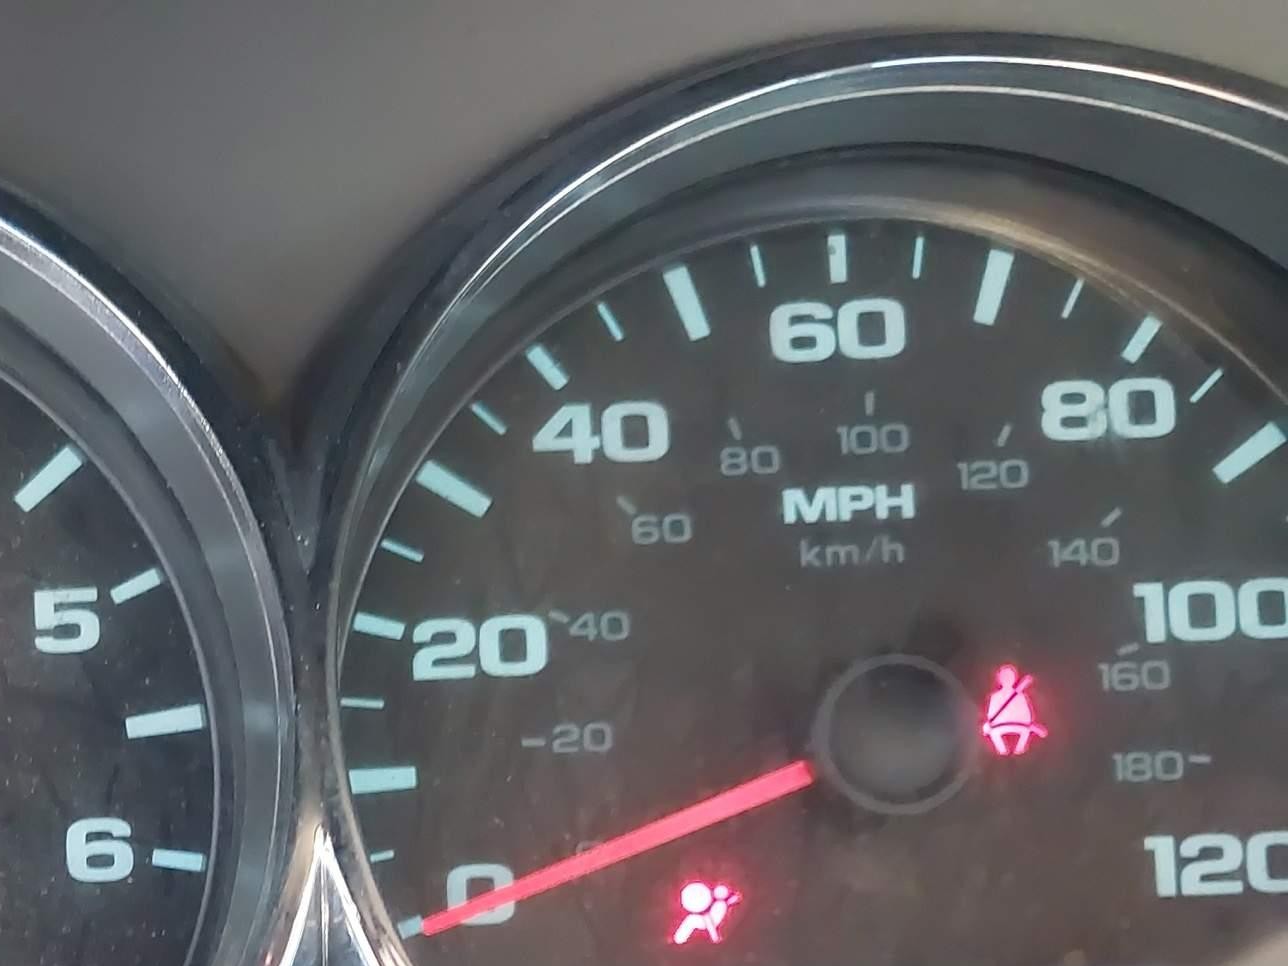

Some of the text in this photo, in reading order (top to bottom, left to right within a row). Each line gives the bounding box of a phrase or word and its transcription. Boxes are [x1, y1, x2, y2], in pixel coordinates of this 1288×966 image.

[769, 298, 906, 363] 60
[1041, 377, 1177, 441] 80
[532, 401, 670, 464] 40
[836, 424, 910, 455] 100
[720, 446, 781, 476] 80
[956, 459, 1029, 490] 120
[781, 483, 916, 525] MPH
[631, 514, 693, 544] 60
[799, 535, 905, 568] km/h
[1047, 537, 1120, 568] 140
[34, 587, 101, 654] 5
[569, 611, 630, 641] 40
[1133, 577, 1288, 643] 100
[412, 614, 549, 681] 20
[1097, 660, 1171, 691] 160
[552, 722, 613, 754] 20
[1112, 750, 1184, 782] 180
[66, 817, 134, 882] 6
[1143, 831, 1288, 898] 120
[446, 863, 516, 926] 0
